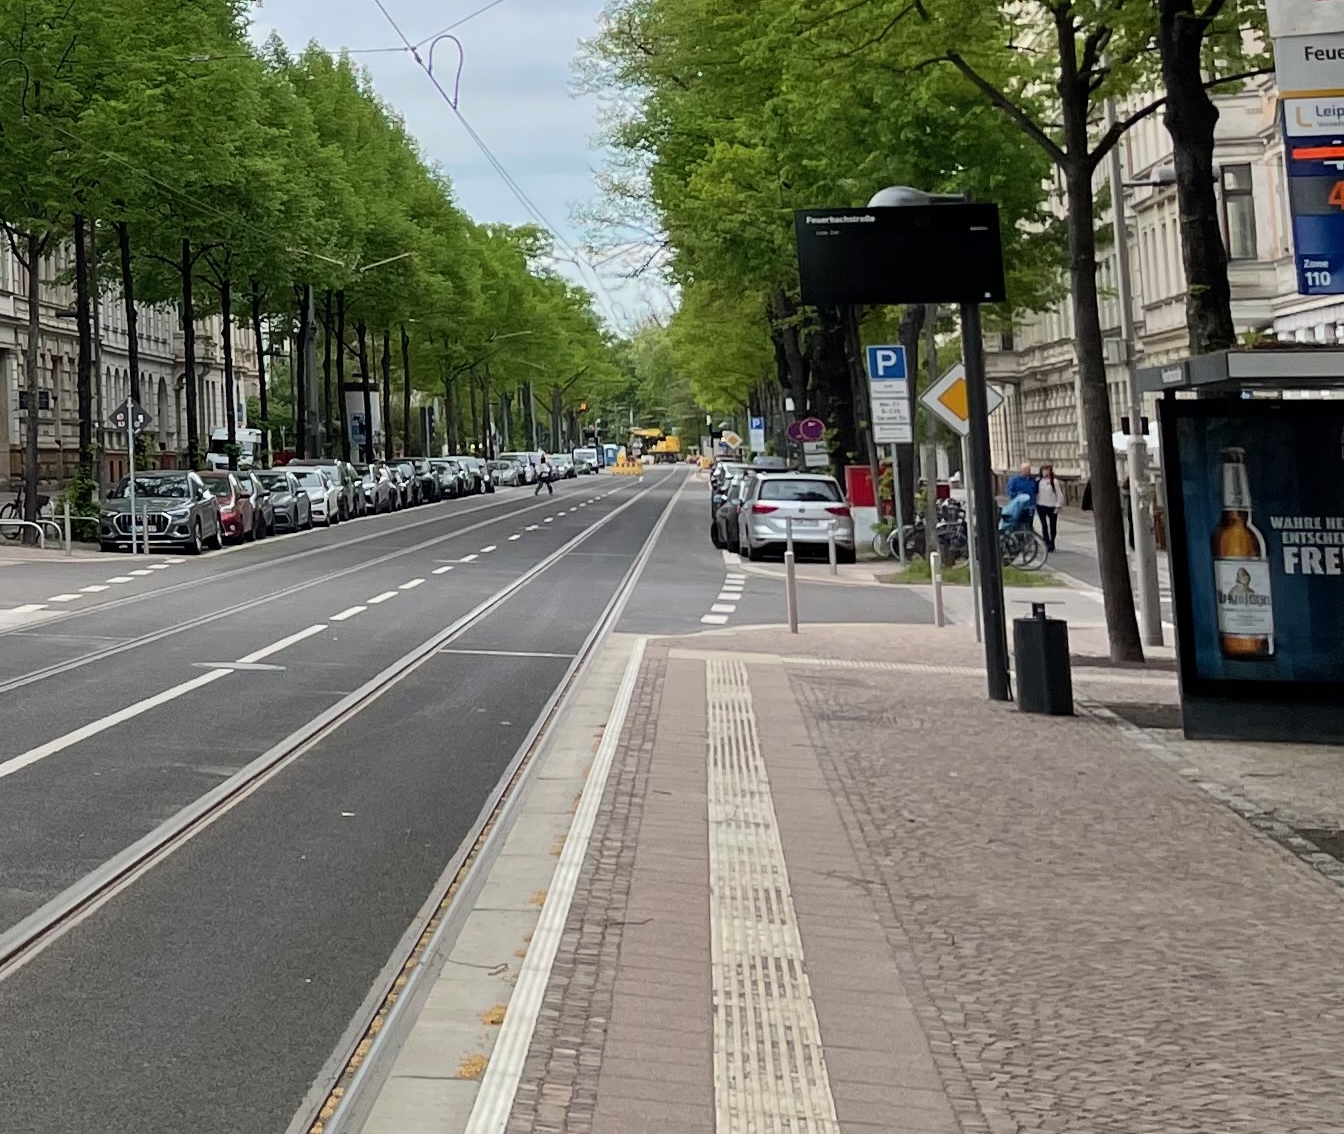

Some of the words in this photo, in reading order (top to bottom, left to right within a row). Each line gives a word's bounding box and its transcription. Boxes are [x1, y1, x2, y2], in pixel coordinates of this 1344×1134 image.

[1305, 271, 1331, 286] 110
[876, 350, 897, 376] P
[1284, 547, 1344, 575] FRE
